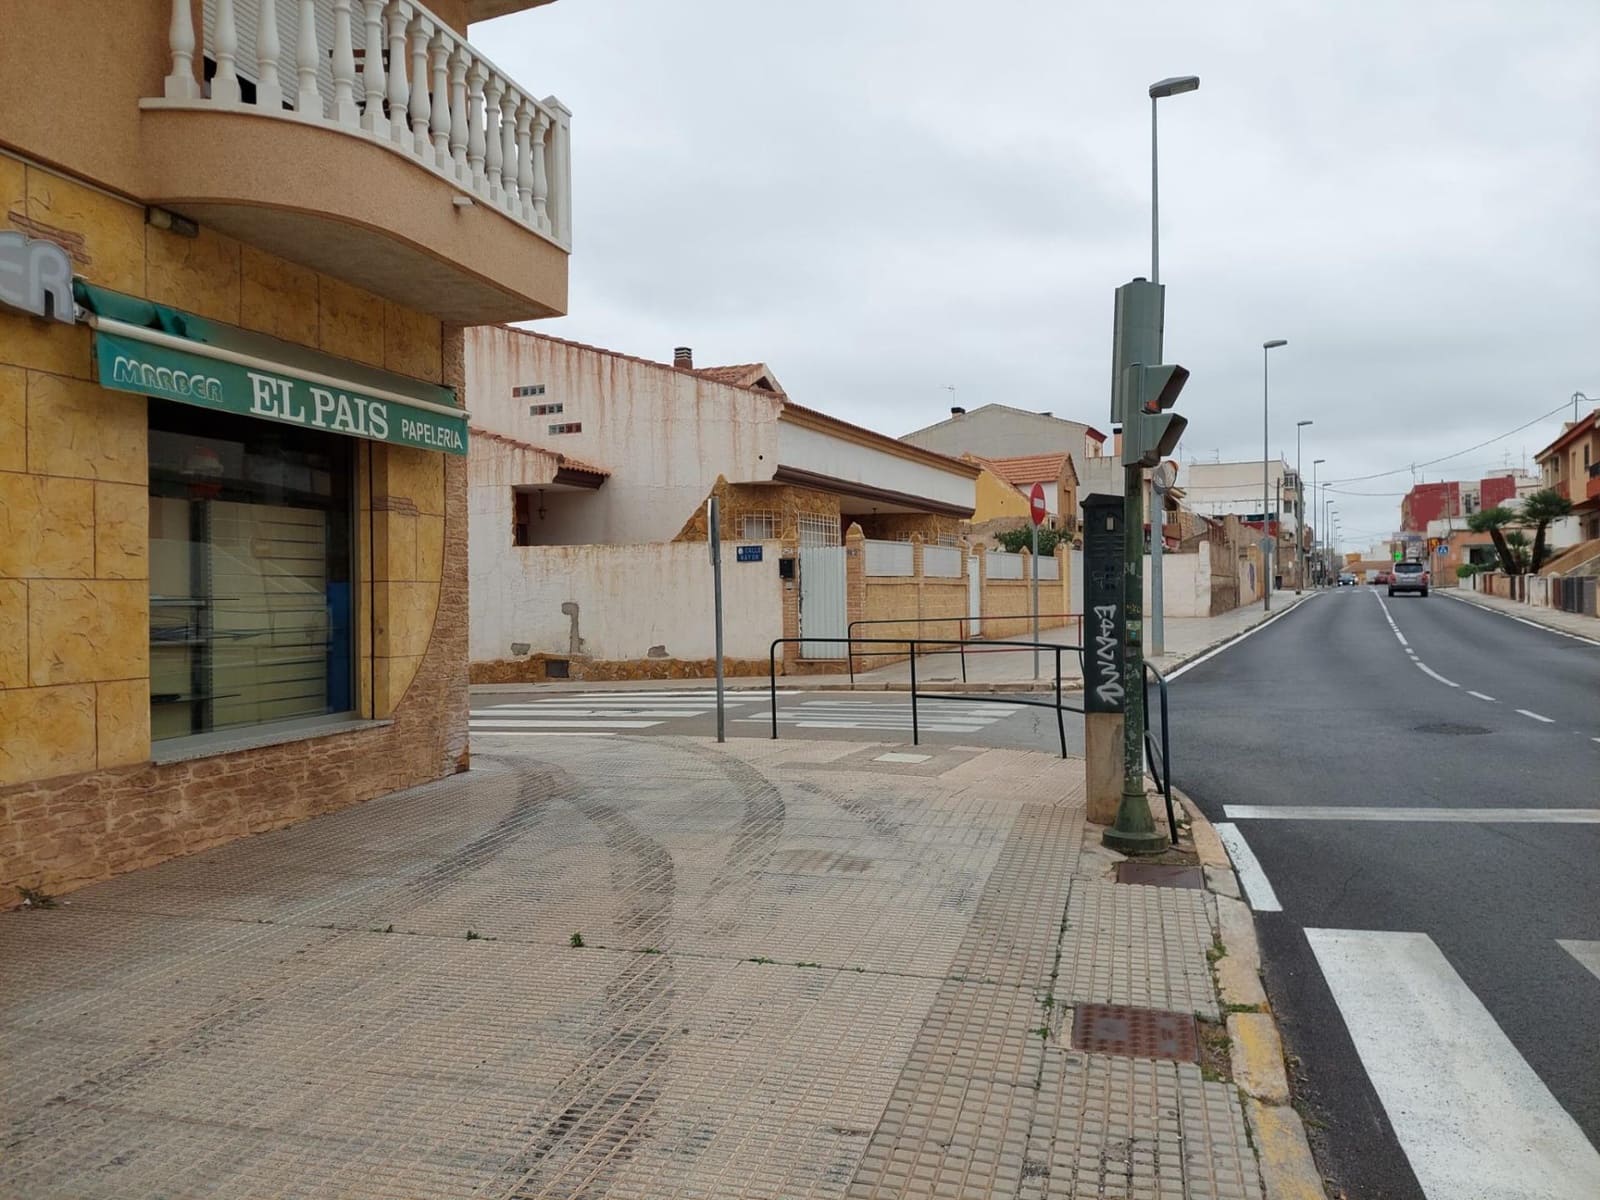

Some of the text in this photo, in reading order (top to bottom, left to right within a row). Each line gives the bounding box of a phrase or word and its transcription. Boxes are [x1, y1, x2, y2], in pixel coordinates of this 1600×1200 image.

[247, 372, 389, 440] EL PAIS
[401, 418, 464, 450] PAPELERIA
